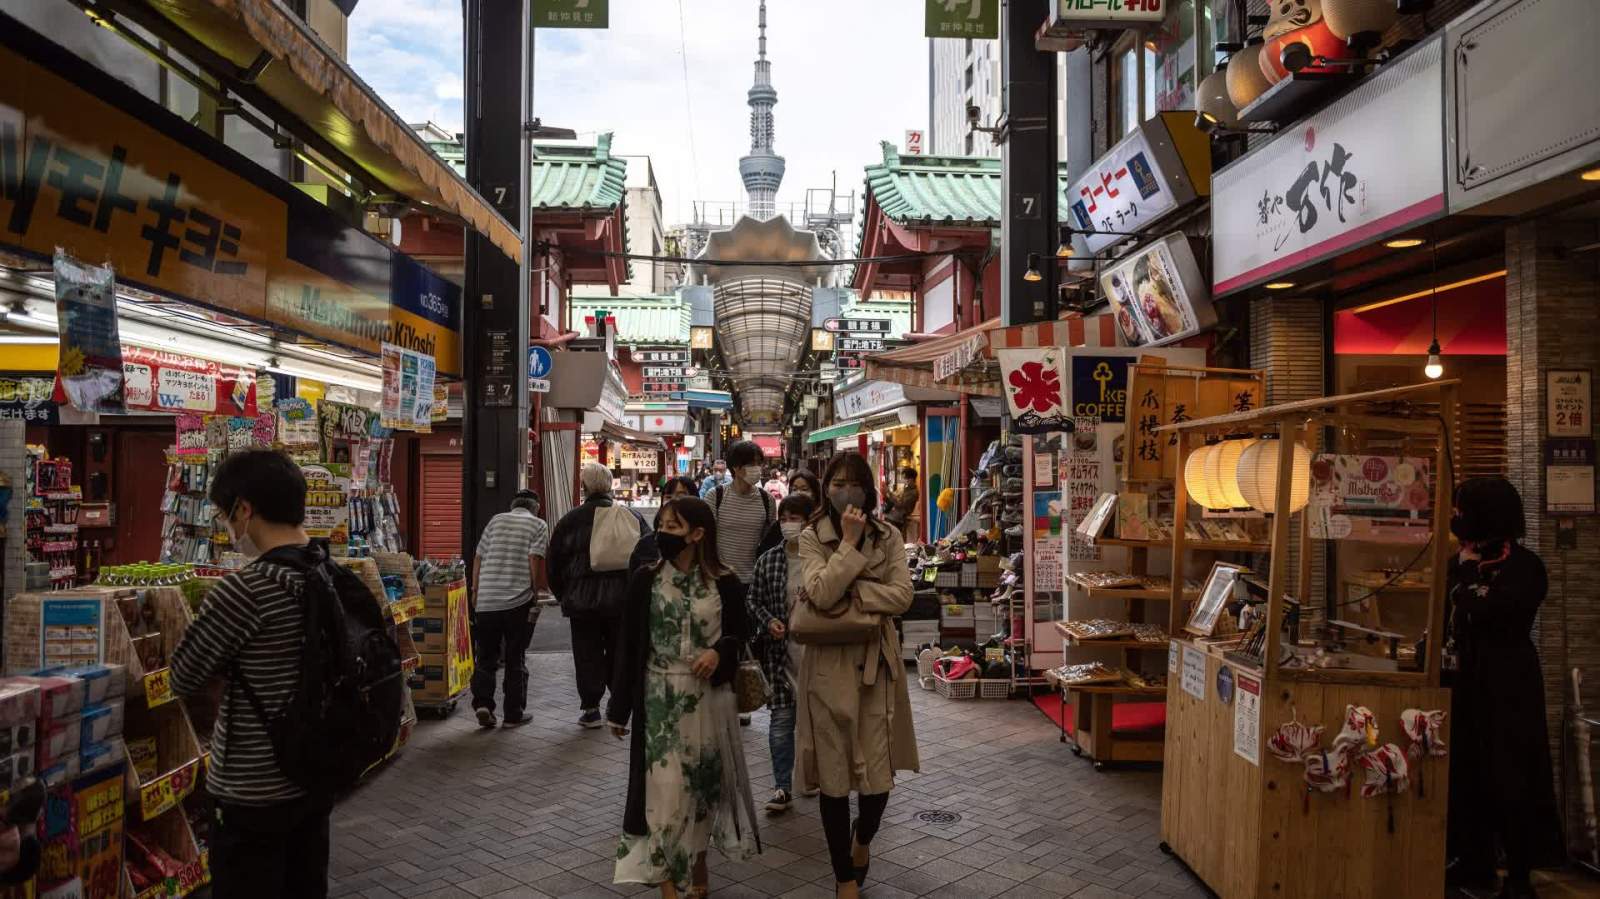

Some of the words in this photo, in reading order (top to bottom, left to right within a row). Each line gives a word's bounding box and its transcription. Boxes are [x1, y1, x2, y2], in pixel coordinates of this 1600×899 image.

[495, 187, 506, 204] 7
[1080, 167, 1128, 214] コーヒー
[1023, 197, 1034, 214] 7
[1116, 202, 1138, 225] ラーク
[503, 384, 511, 396] 7
[1106, 390, 1126, 403] KE
[1075, 403, 1124, 417] COFFE
[1070, 465, 1098, 479] オムライス
[1070, 482, 1098, 496] テイクアウト
